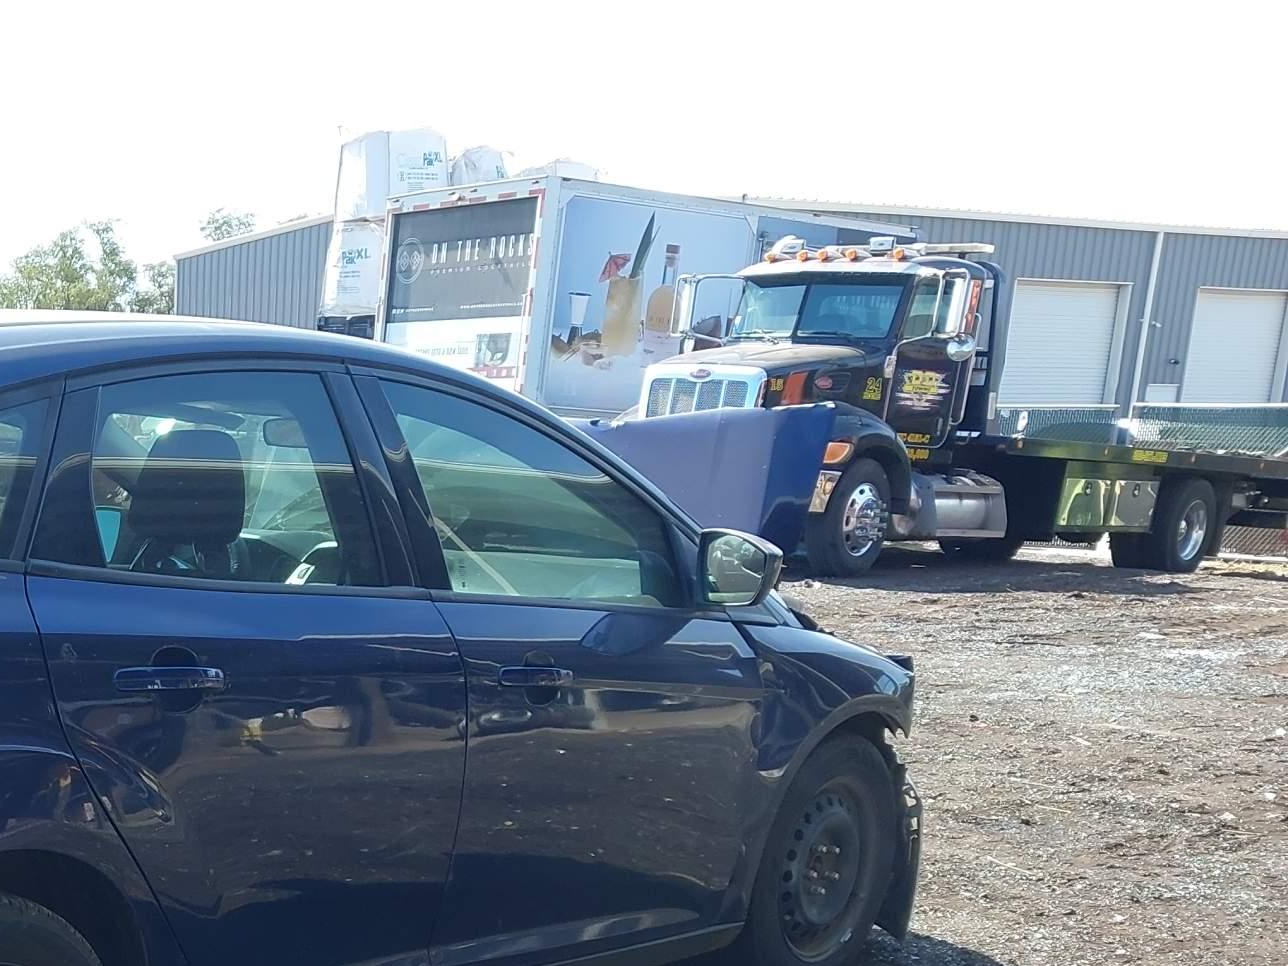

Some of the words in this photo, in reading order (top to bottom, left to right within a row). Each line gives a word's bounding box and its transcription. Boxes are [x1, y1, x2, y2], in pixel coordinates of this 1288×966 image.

[431, 242, 448, 264] ON
[456, 238, 481, 262] THE
[489, 232, 534, 259] ROCKS
[865, 376, 883, 394] 24
